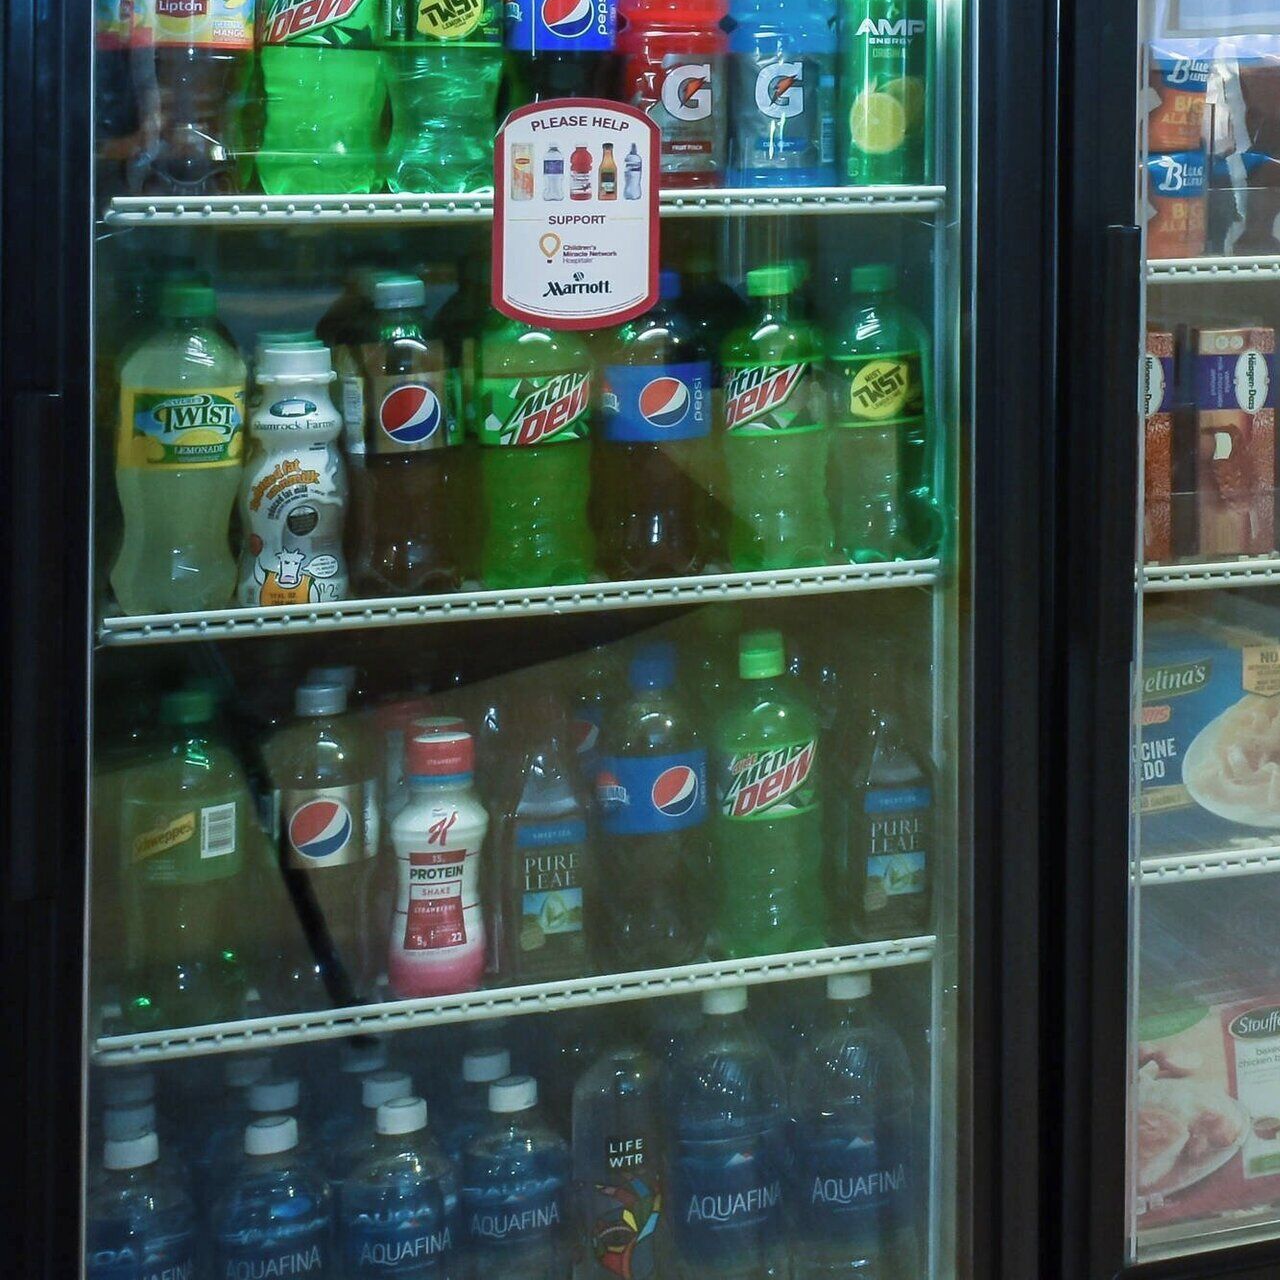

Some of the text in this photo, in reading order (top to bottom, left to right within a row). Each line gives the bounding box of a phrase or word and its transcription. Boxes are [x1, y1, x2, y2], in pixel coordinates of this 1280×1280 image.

[158, 0, 203, 13] Lipton
[213, 28, 246, 37] MANGO
[854, 18, 926, 36] AMP
[868, 36, 914, 45] ENERGY
[661, 63, 712, 121] G
[754, 62, 805, 120] G
[530, 115, 630, 132] PLEASE HELP
[548, 215, 606, 225] SUPPORT
[542, 279, 613, 297] Marriott
[693, 377, 704, 422] pepsi
[162, 396, 236, 432] TWIST
[253, 419, 335, 431] Shamrock Farms
[173, 443, 226, 456] LEMONADE
[1260, 652, 1279, 664] NO
[872, 819, 922, 838] PURE
[871, 835, 920, 853] LEAF
[525, 853, 579, 872] PURE
[409, 864, 464, 881] PROTEIN
[525, 871, 576, 891] LEAF
[421, 885, 451, 896] SHAKE
[609, 1138, 644, 1154] LIFE
[609, 1153, 644, 1169] WTR
[811, 1163, 905, 1205] AQUAFINA
[686, 1181, 784, 1223] AQUAFINA
[470, 1204, 560, 1240] AQUAFINA
[360, 1227, 453, 1268] AQUAFINA
